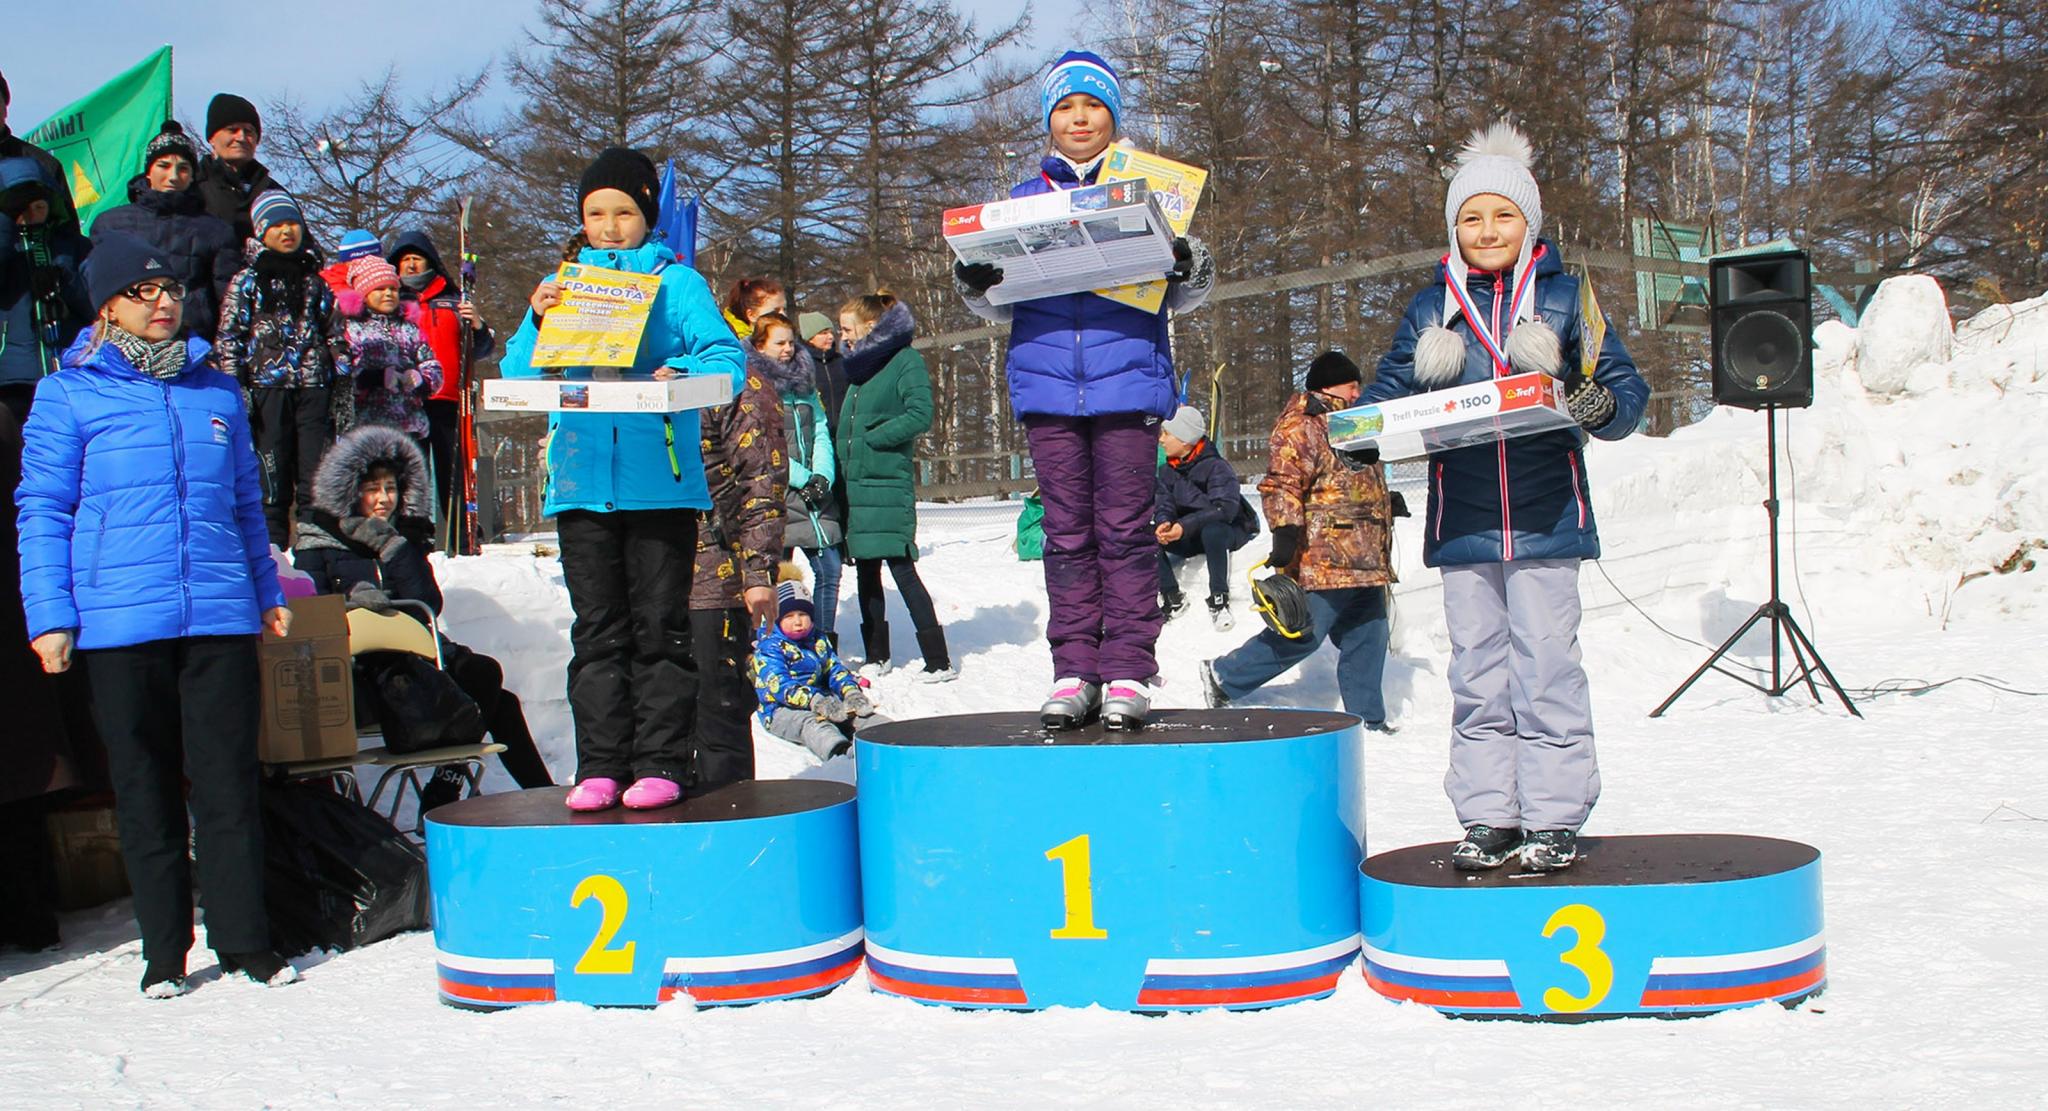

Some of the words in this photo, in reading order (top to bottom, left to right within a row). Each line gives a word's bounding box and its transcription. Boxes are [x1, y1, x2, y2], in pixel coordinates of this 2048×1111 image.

[564, 281, 644, 300] ГРАМОТА
[1460, 394, 1491, 409] 1500
[1514, 386, 1536, 398] Trefl
[635, 401, 664, 410] 1000
[1044, 833, 1108, 939] 1
[570, 874, 636, 974] 2
[1541, 903, 1614, 1013] 3
